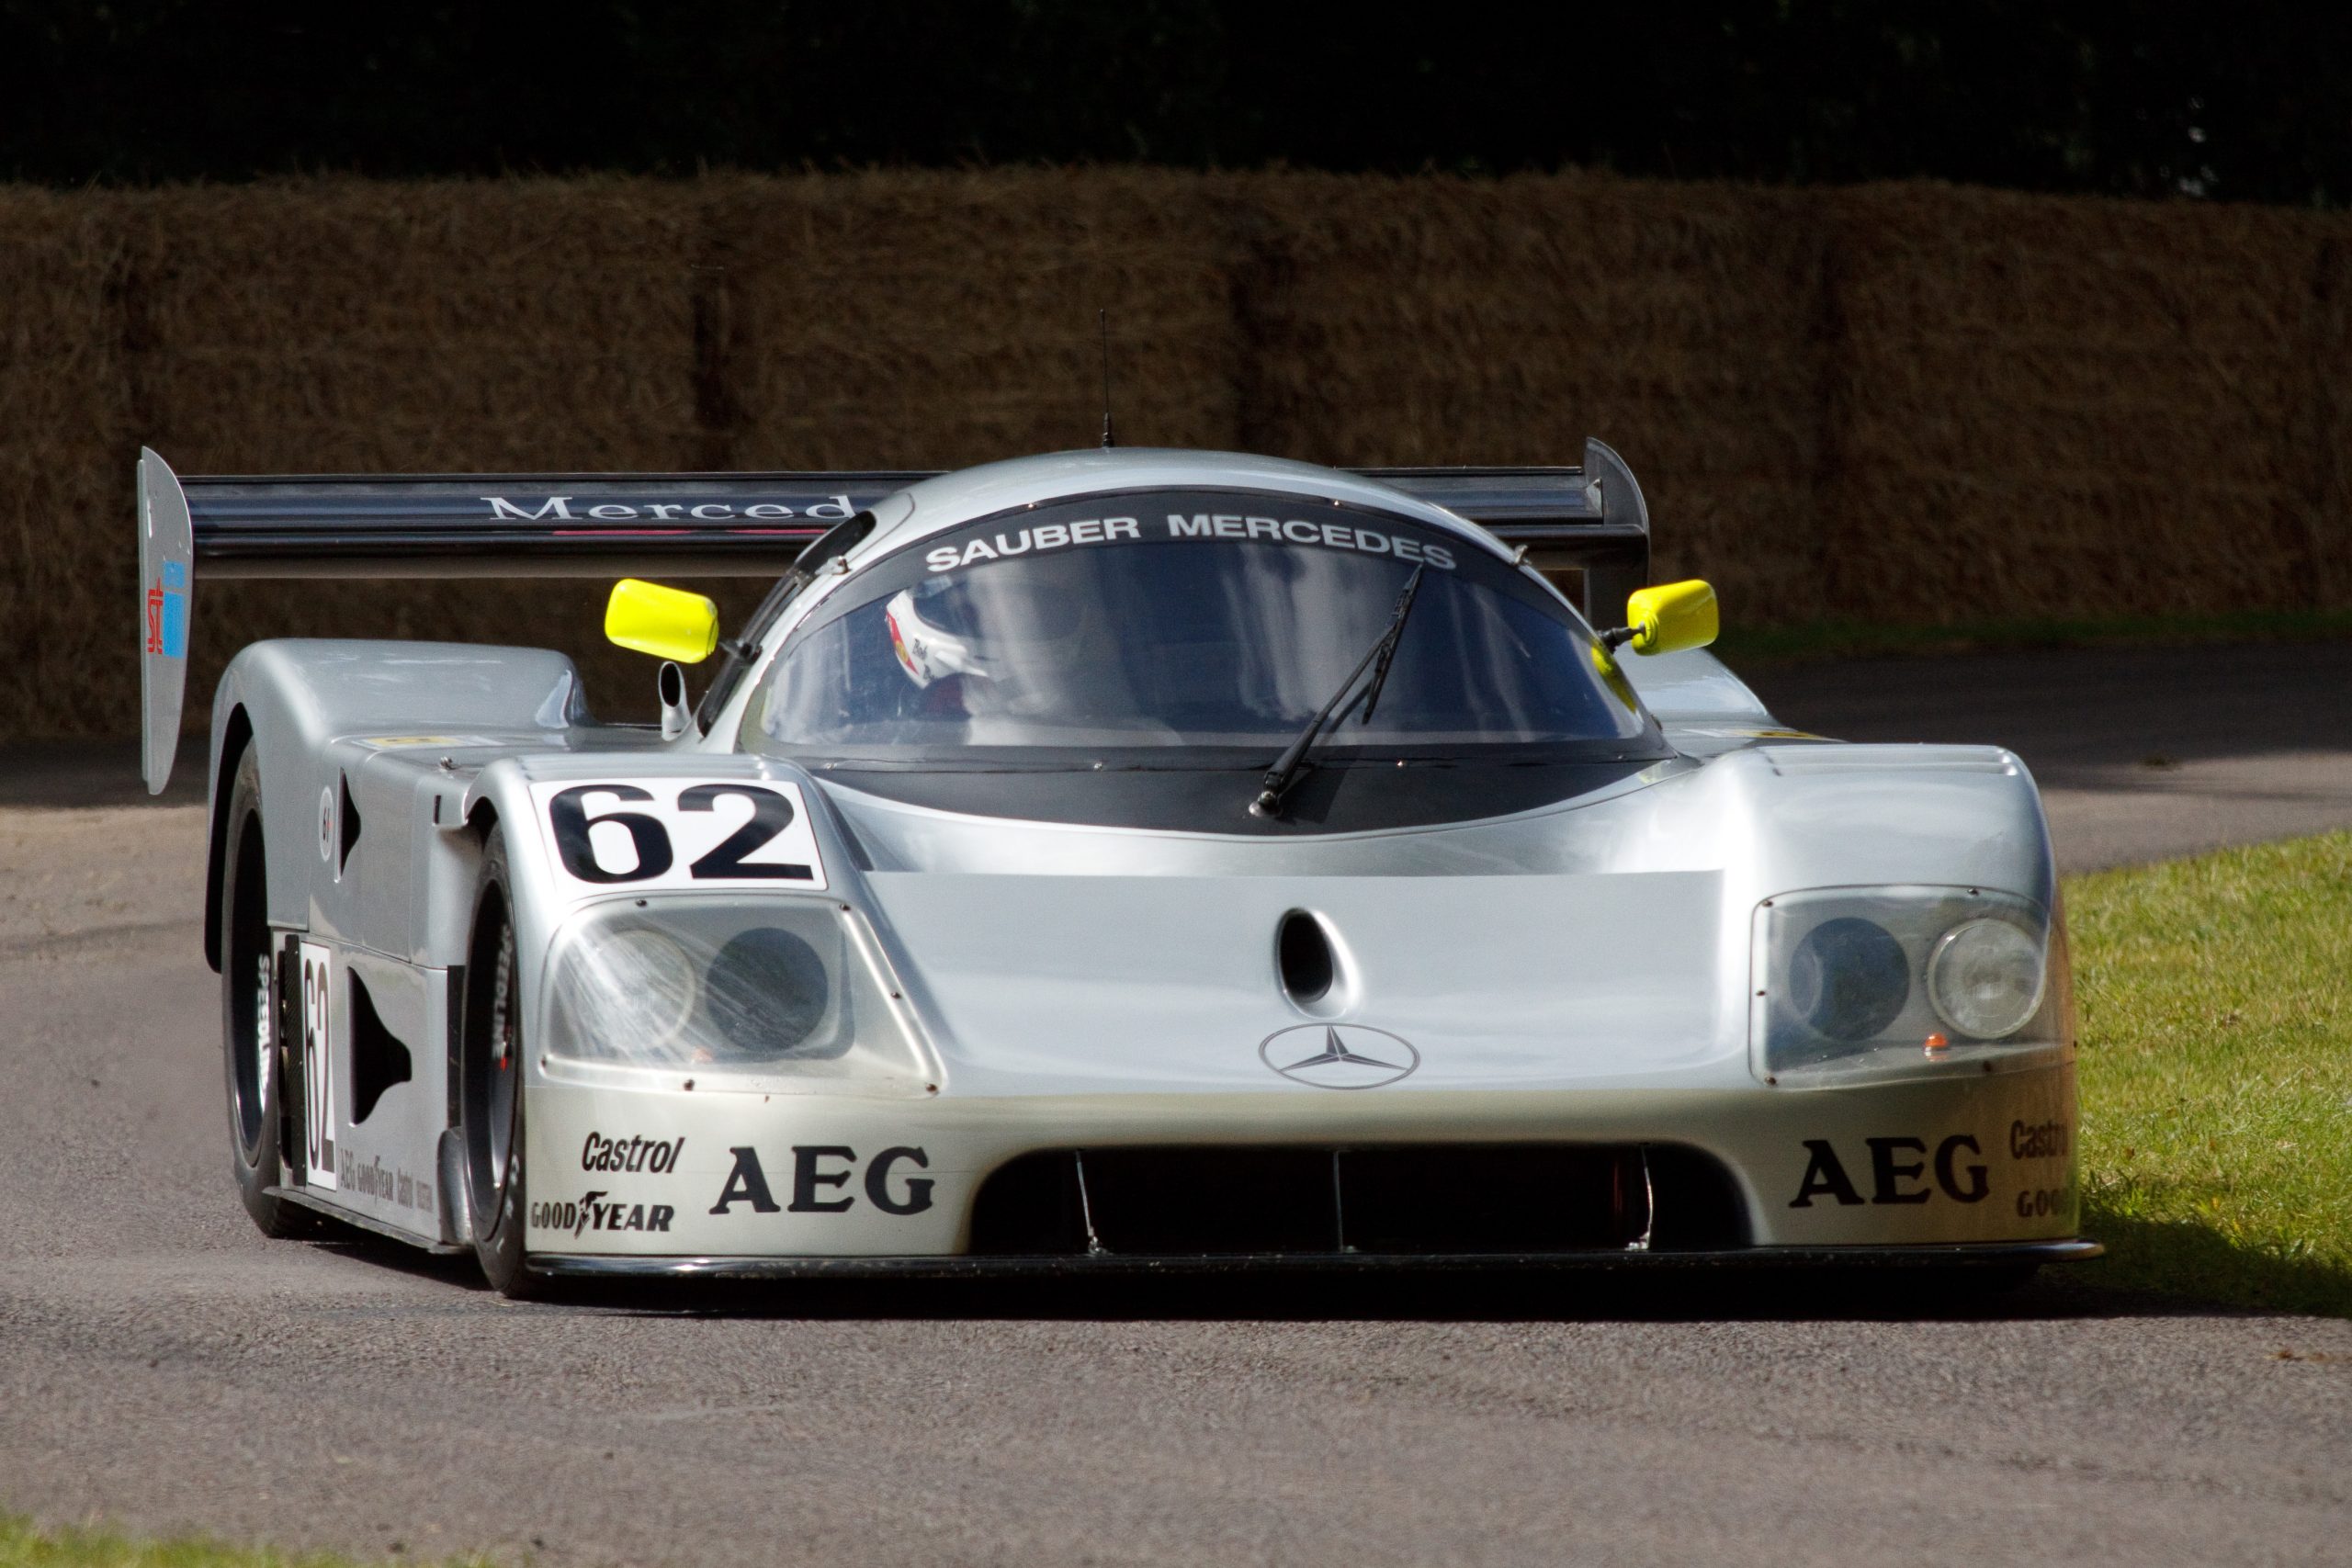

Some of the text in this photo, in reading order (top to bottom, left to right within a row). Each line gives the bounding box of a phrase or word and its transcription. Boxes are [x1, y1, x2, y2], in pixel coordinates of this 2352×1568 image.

[925, 513, 1456, 573] SAUBER MERCEDES
[548, 783, 814, 884] 62
[304, 957, 335, 1173] 62
[581, 1131, 685, 1174] Castrol
[708, 1145, 935, 1216] AEG
[1788, 1134, 1990, 1209] AEG
[530, 1190, 674, 1239] GOODYEAR
